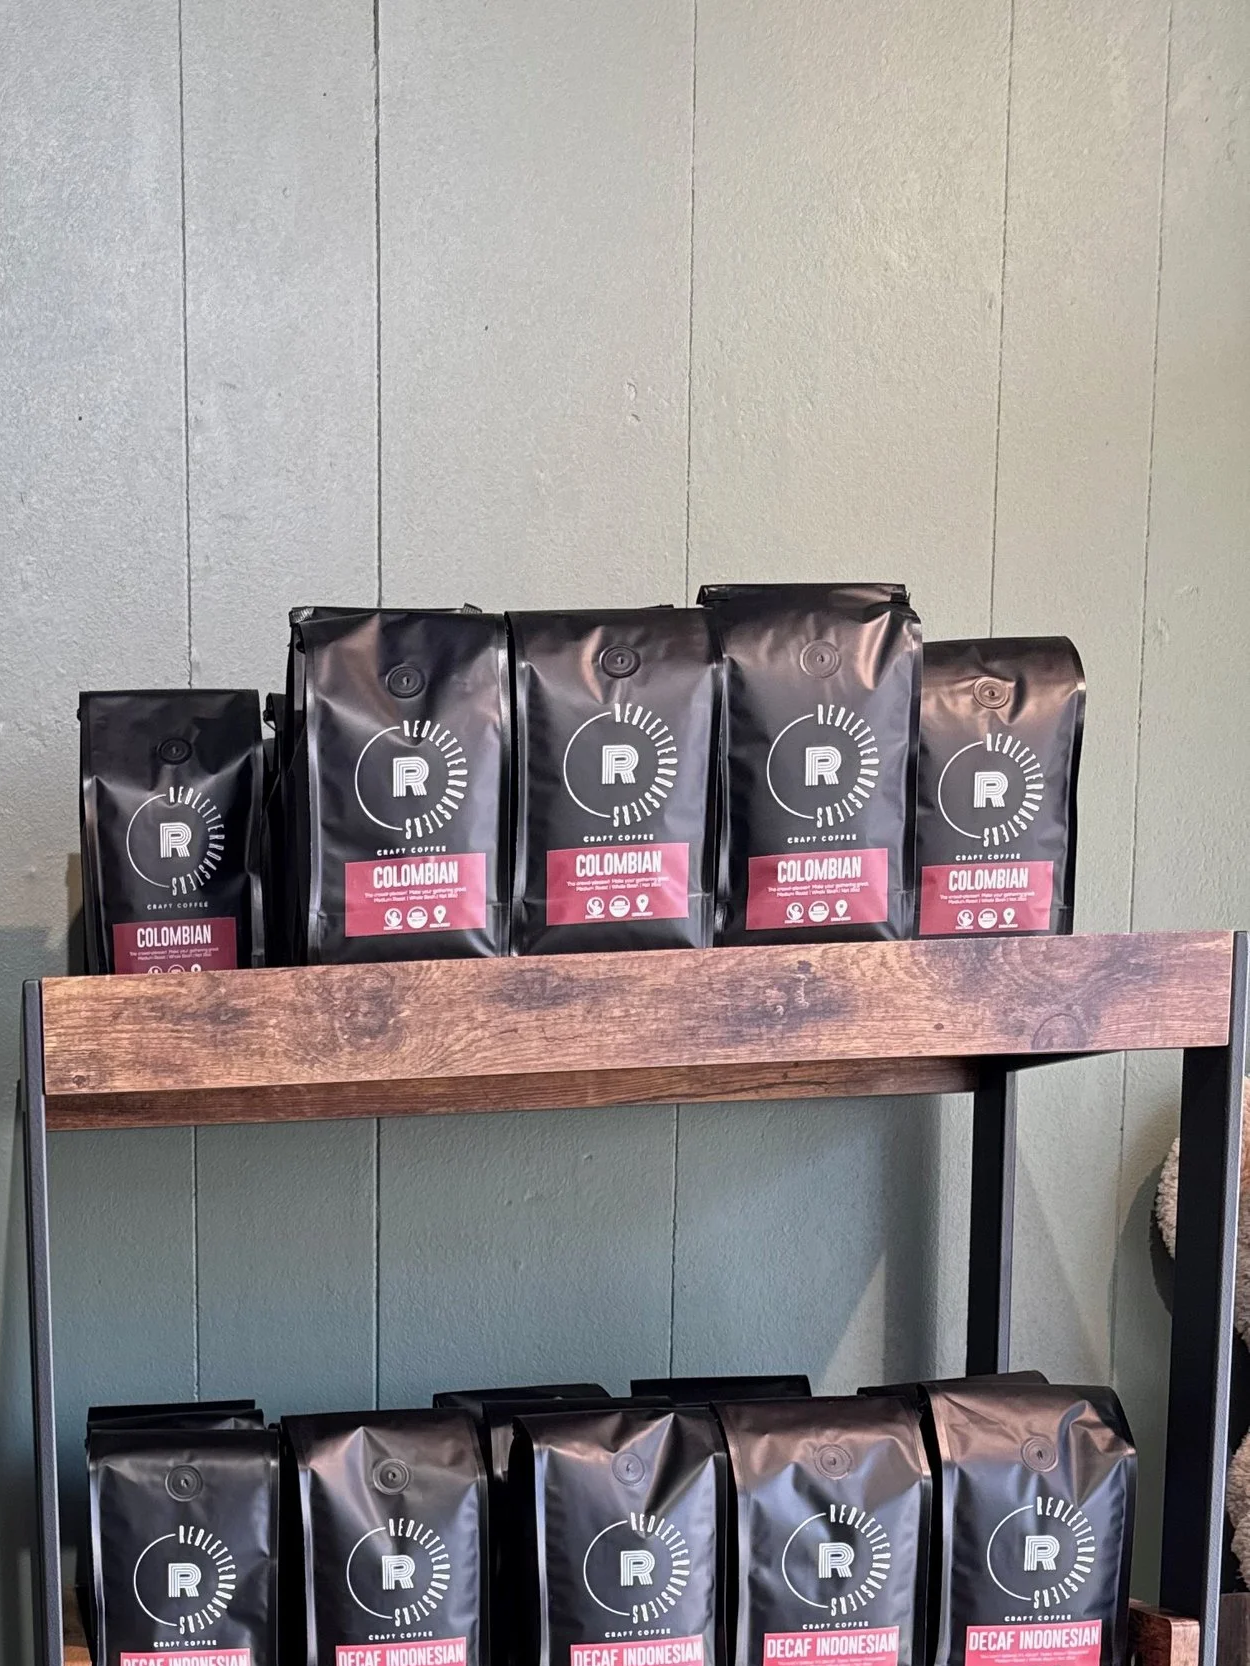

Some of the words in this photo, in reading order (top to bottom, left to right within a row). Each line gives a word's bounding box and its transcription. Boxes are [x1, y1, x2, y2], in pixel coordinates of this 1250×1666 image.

[392, 757, 429, 798] R
[602, 745, 639, 785] R
[805, 746, 842, 786] R
[974, 772, 1008, 808] R
[160, 822, 192, 859] R
[377, 848, 405, 856] CRAFT
[787, 836, 816, 844] CRAFT
[822, 834, 857, 842] COFFEE
[373, 861, 458, 889] COLOMBIAN
[576, 851, 662, 877] COLOMBIAN
[777, 856, 861, 883] COLOMBIAN
[949, 868, 1029, 892] COLOMBIAN
[137, 925, 212, 947] COLOMBIAN
[621, 1550, 655, 1586] R
[819, 1543, 854, 1578] R
[1024, 1535, 1060, 1571] R
[168, 1563, 201, 1598] R
[382, 1555, 415, 1590] R
[623, 1642, 702, 1666] INDONESIAN
[767, 1638, 812, 1659] DECAF
[817, 1632, 897, 1656] INDONESIAN
[969, 1631, 1015, 1651] DECAF
[1020, 1626, 1099, 1649] INDONESIAN
